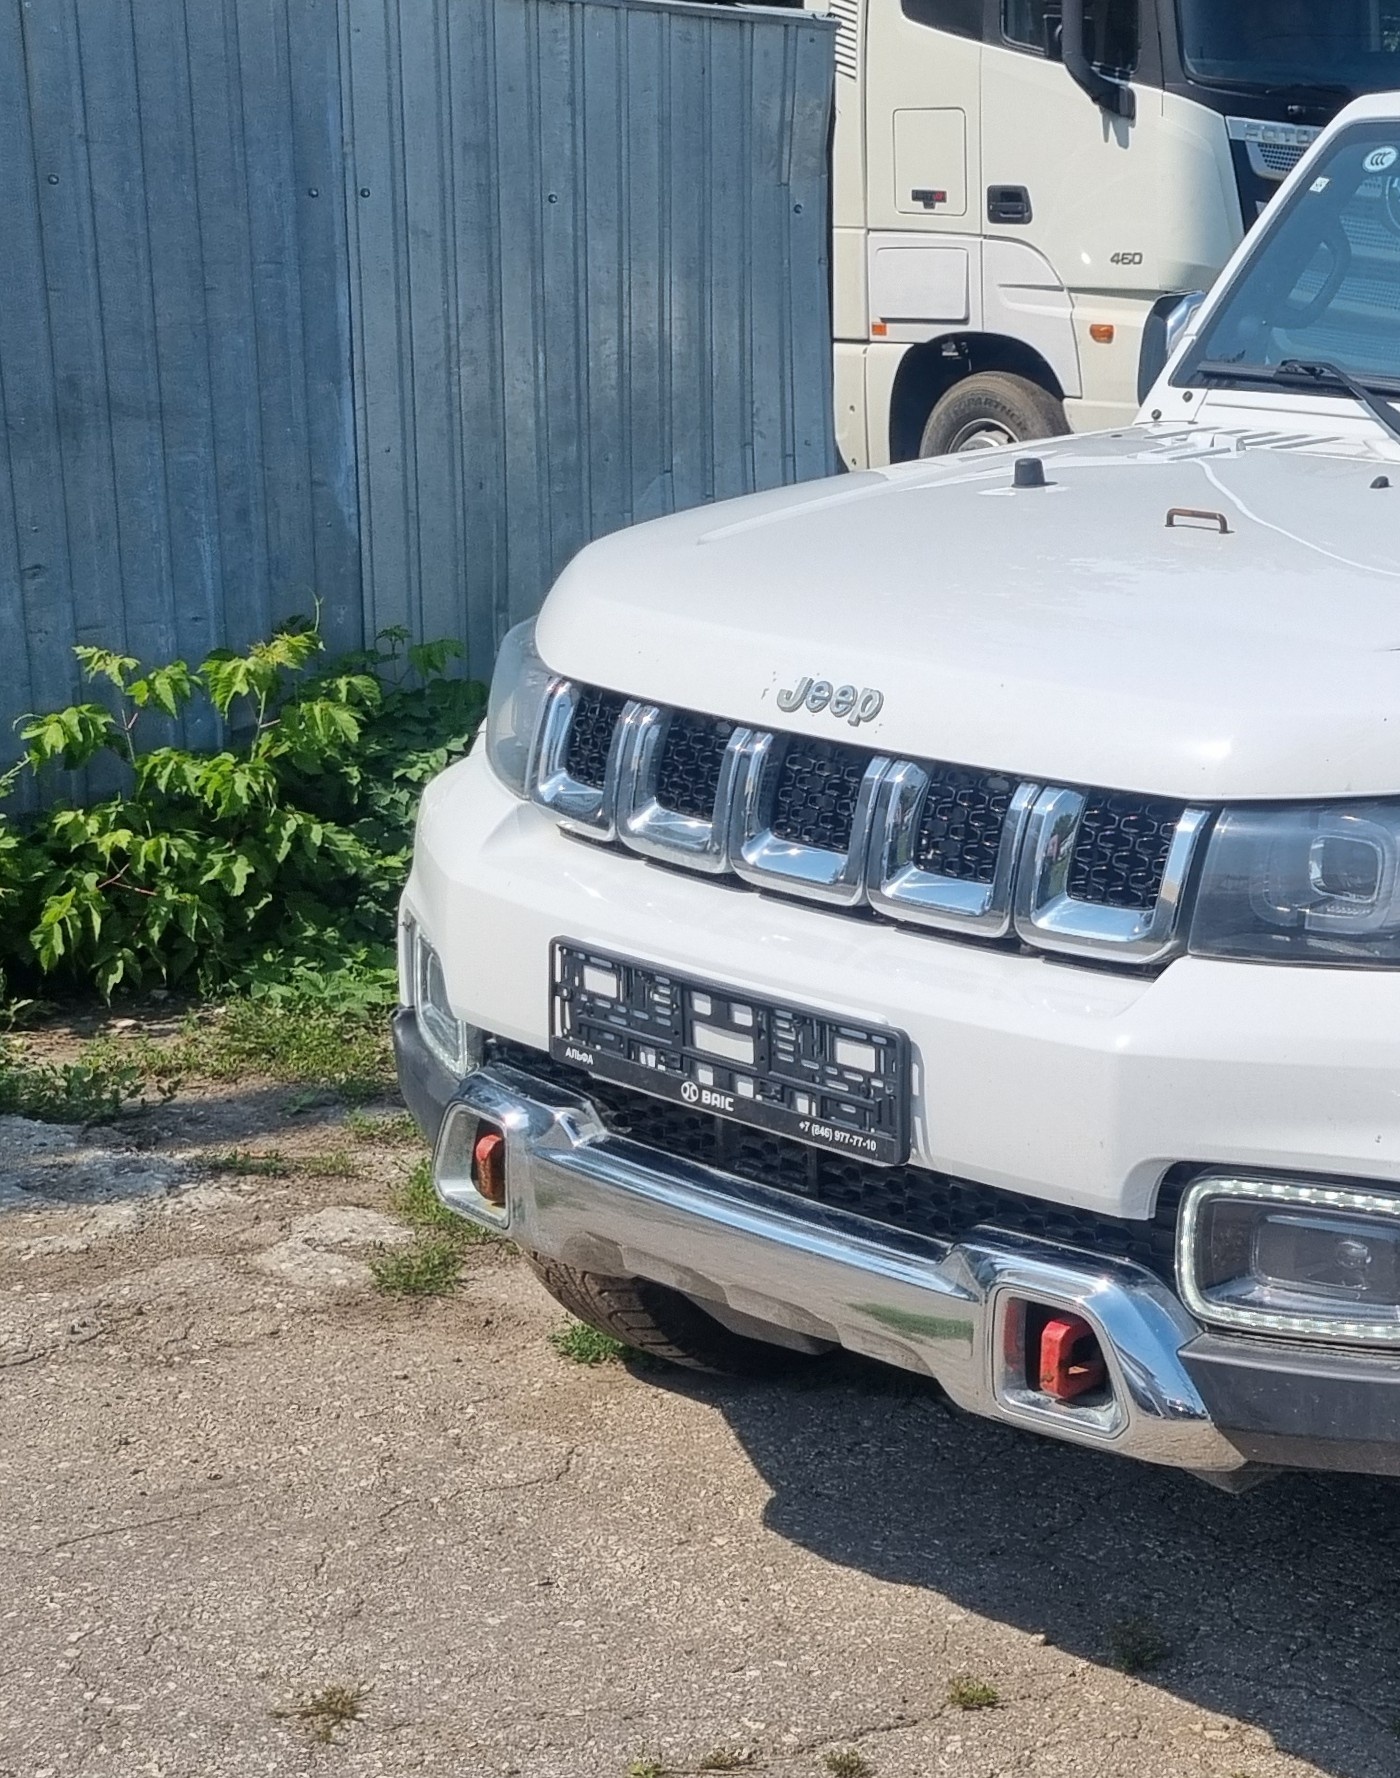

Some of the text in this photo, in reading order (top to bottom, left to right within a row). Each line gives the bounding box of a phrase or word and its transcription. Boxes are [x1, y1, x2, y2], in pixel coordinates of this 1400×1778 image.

[1110, 252, 1143, 265] 460
[776, 676, 885, 727] Jeep
[565, 1046, 594, 1065] АЛЬФА
[701, 1089, 734, 1112] BAIC
[799, 1121, 877, 1151] +7 (846) 977-77-10
